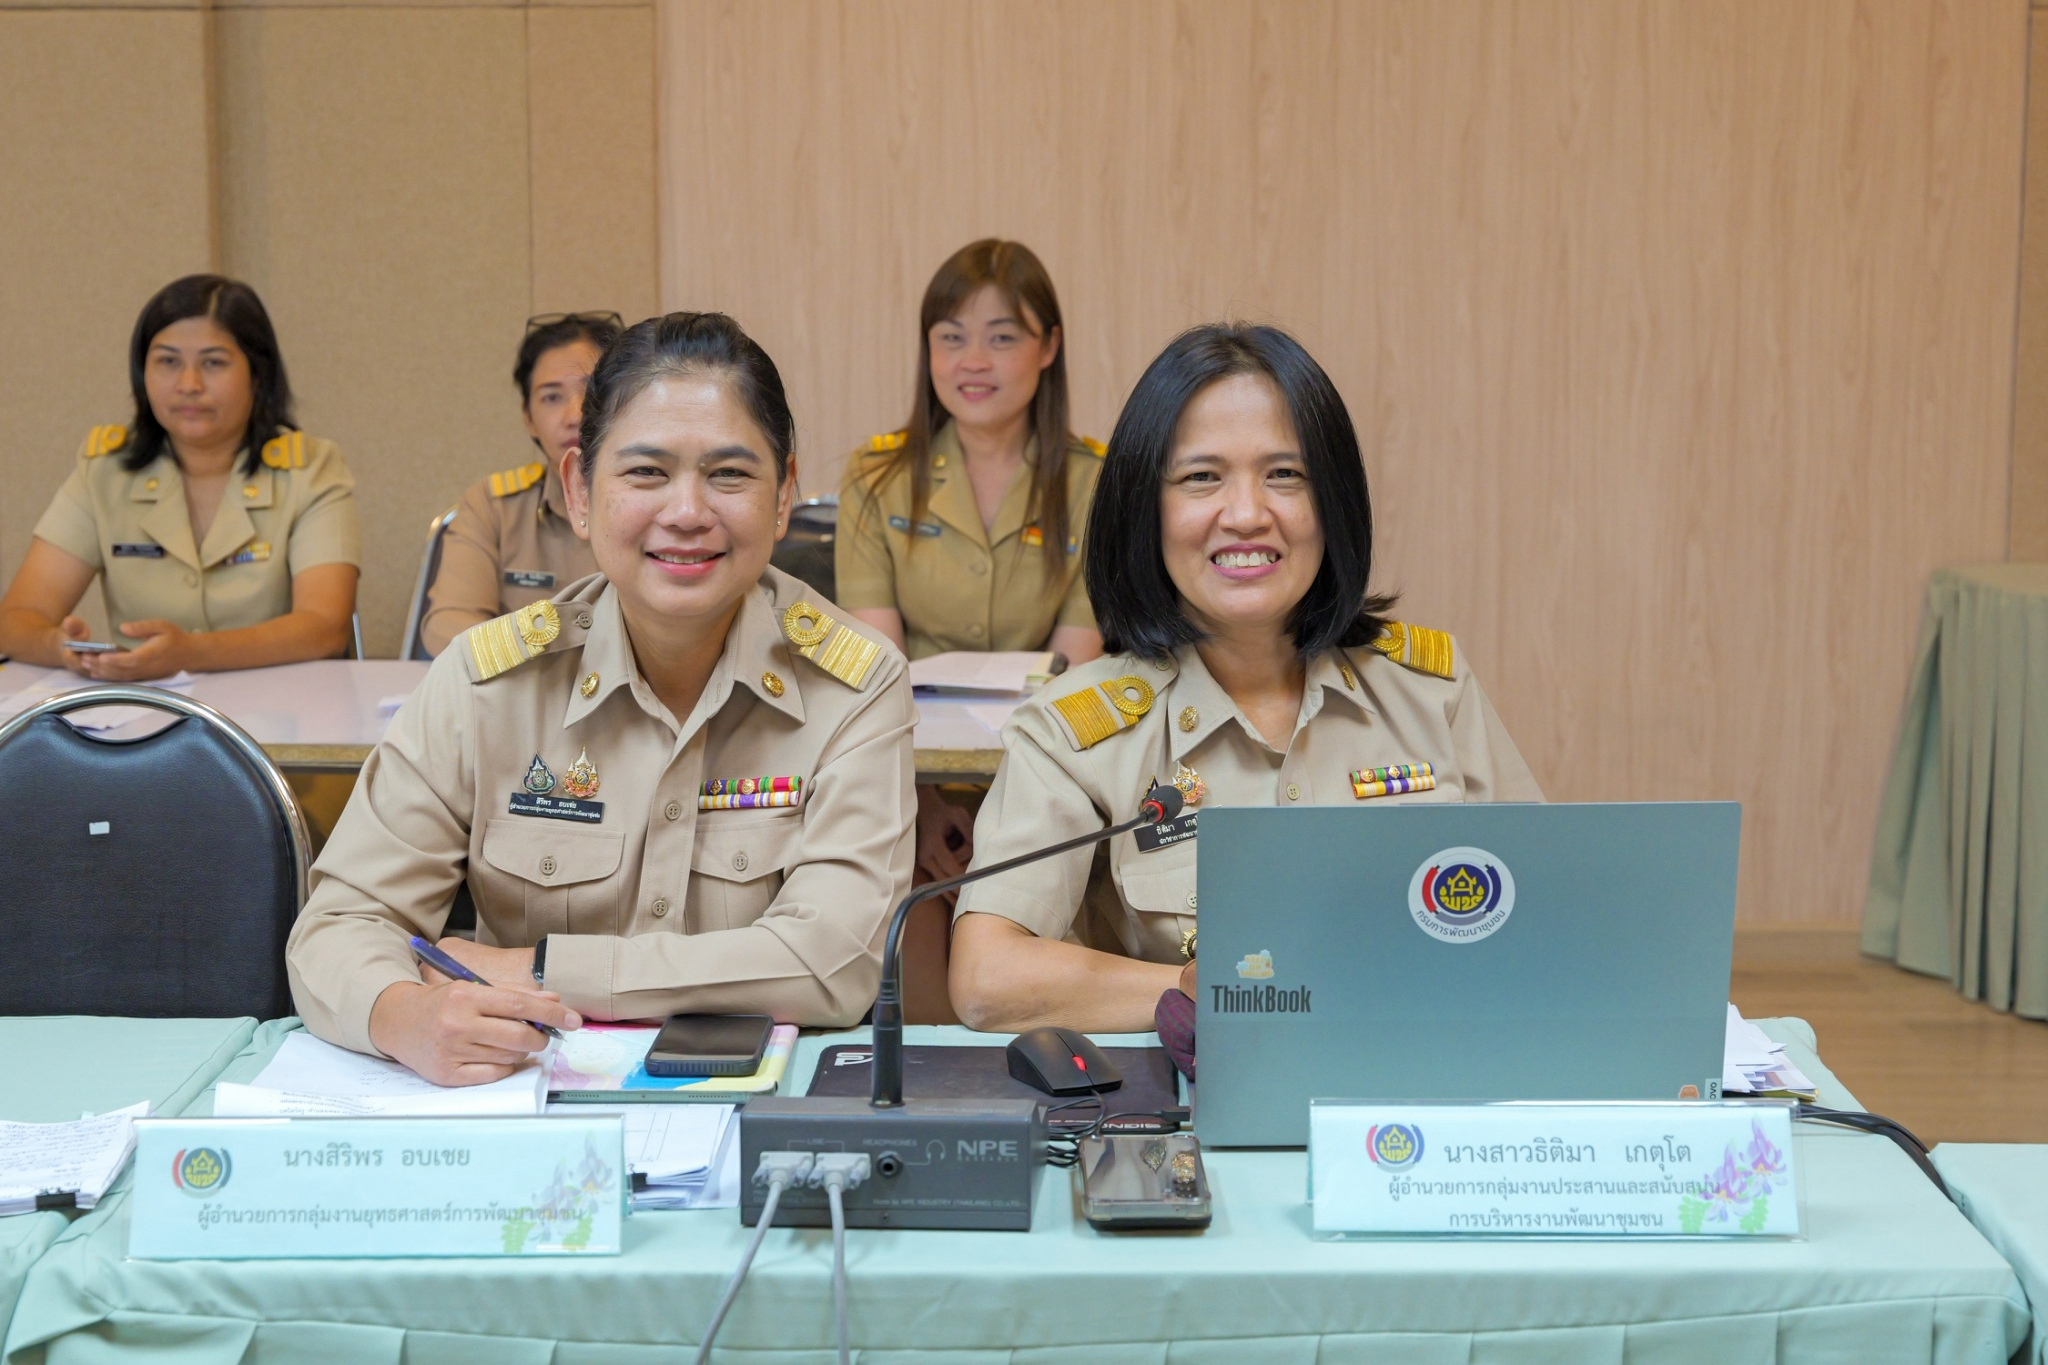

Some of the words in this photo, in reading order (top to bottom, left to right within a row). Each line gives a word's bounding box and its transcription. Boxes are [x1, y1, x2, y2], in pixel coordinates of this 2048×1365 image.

[1416, 910, 1506, 937] กรมการพัฒนาชุมชน
[1211, 985, 1312, 1013] ThinkBook
[1709, 1082, 1717, 1099] ovo
[283, 1141, 384, 1168] นางสิริพร
[401, 1145, 471, 1168] อบเชย
[957, 1140, 1019, 1157] NPE
[1444, 1137, 1596, 1164] นางสาวธิติมา
[1624, 1135, 1692, 1172] เกตุโต
[1388, 1175, 1722, 1202] ผู้อำนวยการกลุ่มงานประสานและสนับสนุน
[197, 1203, 584, 1231] ผู้อำนวยการกลุ่มงานยุทธศาสตร์การพัฒนาชุมชน
[1448, 1207, 1664, 1233] การบริหารงานพัฒนาชุมชน
